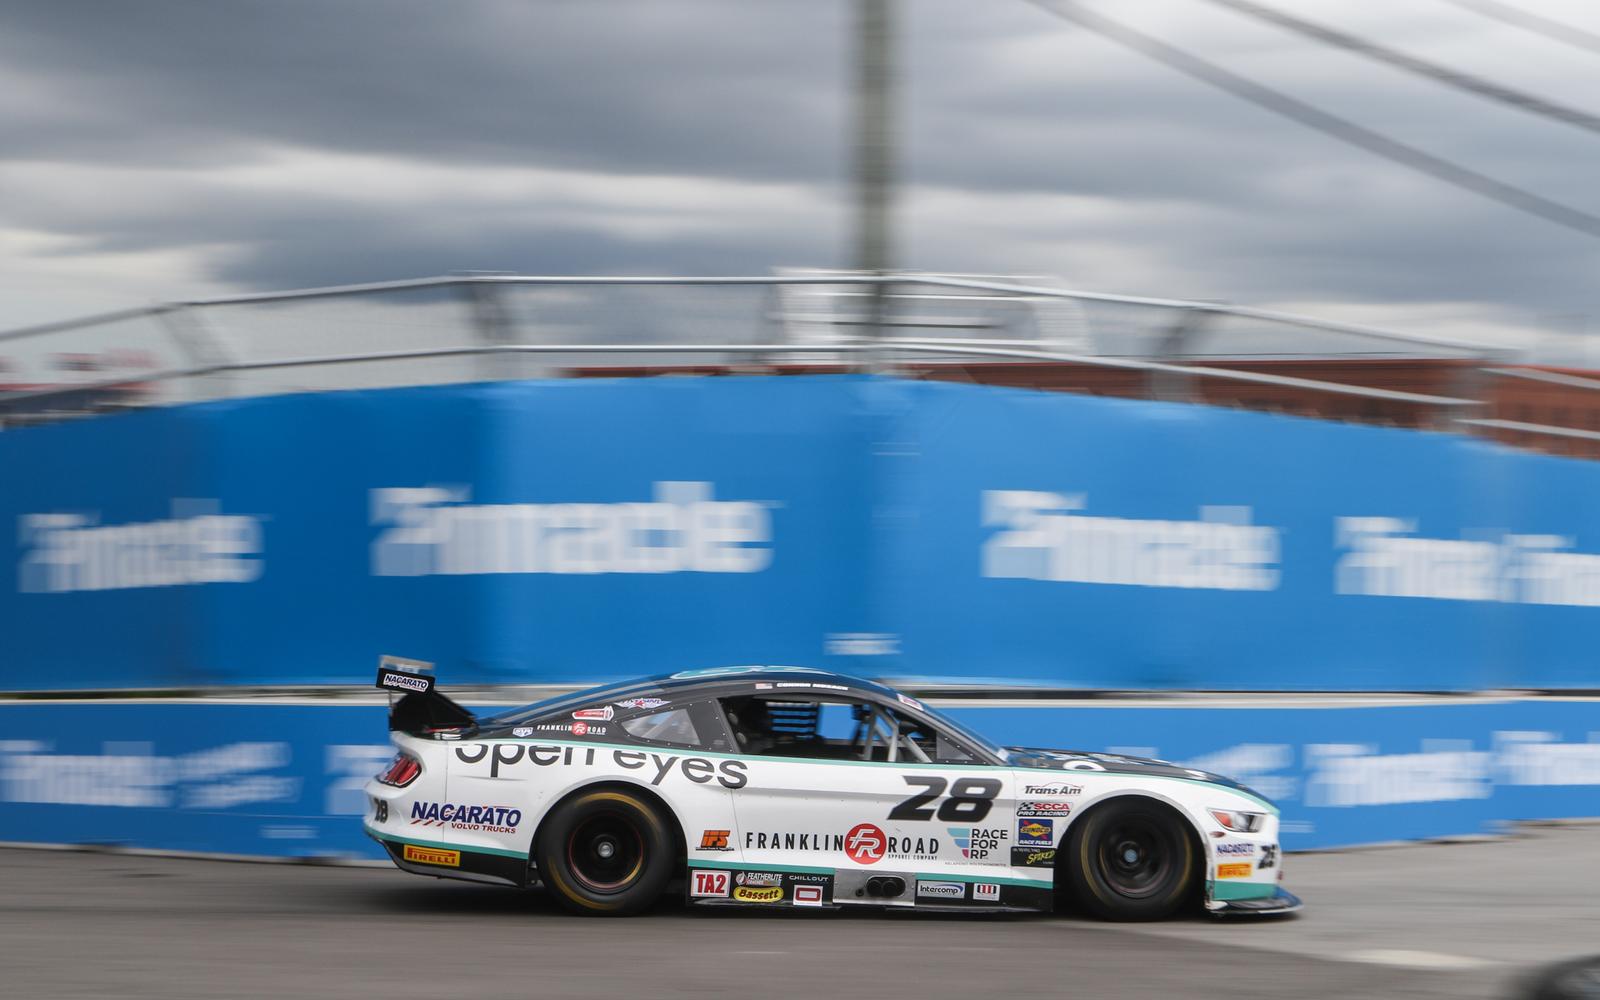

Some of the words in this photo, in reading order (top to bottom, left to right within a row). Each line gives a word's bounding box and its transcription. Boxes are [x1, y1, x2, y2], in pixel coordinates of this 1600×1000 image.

[385, 674, 428, 689] NACARATO
[537, 724, 572, 732] FRANKLIN
[587, 726, 607, 734] ROAD
[613, 750, 747, 789] eyes
[1025, 785, 1059, 795] Trans
[1060, 785, 1081, 794] Am
[886, 775, 1003, 822] 28
[411, 801, 522, 828] NACARATO
[451, 822, 479, 831] VOLVO
[482, 825, 516, 834] TRUCKS
[971, 829, 1008, 840] RACE
[746, 832, 844, 851] FRANKLIN
[888, 837, 939, 854] ROAD
[971, 839, 998, 850] FOR
[406, 847, 457, 864] PIRELLI
[970, 849, 988, 860] RP
[747, 872, 783, 881] FEATHERLITE
[696, 874, 726, 893] TA2
[740, 889, 779, 899] Bassett
[920, 885, 958, 895] Intercomp
